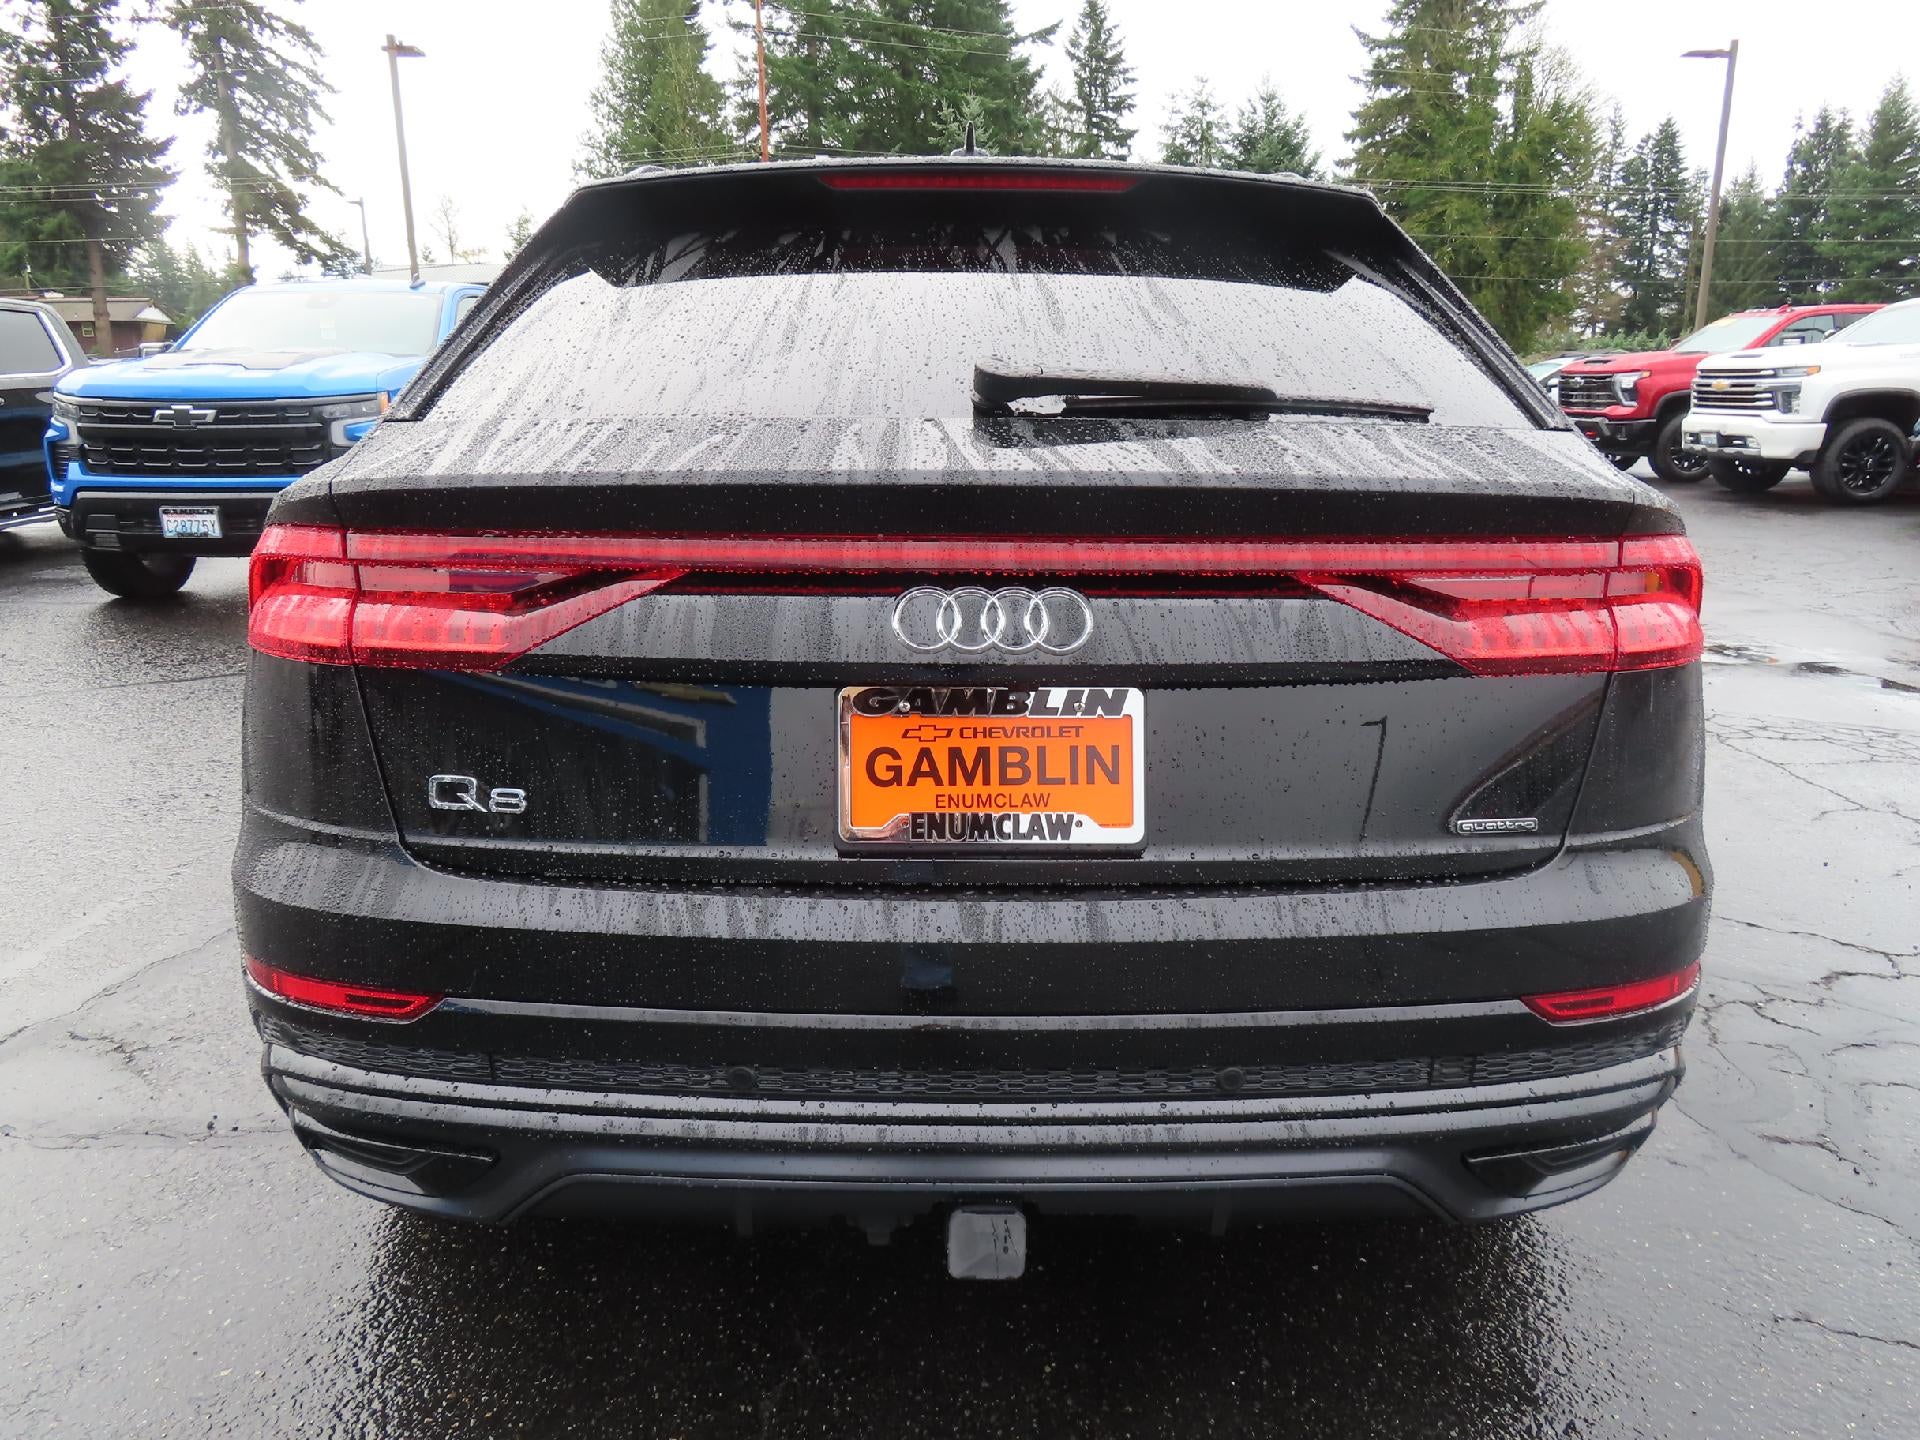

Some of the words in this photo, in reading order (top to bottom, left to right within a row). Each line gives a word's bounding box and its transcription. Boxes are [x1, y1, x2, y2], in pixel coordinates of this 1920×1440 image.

[166, 519, 217, 534] C28775Y
[852, 687, 1132, 717] GAMBLIN
[958, 725, 1084, 739] CHEVROLET
[865, 744, 1120, 787] GAMBLIN
[428, 774, 527, 814] Q8
[935, 793, 1051, 809] ENUMCLAW
[909, 812, 1075, 841] ENUMCLAW
[1461, 821, 1536, 832] quattro
